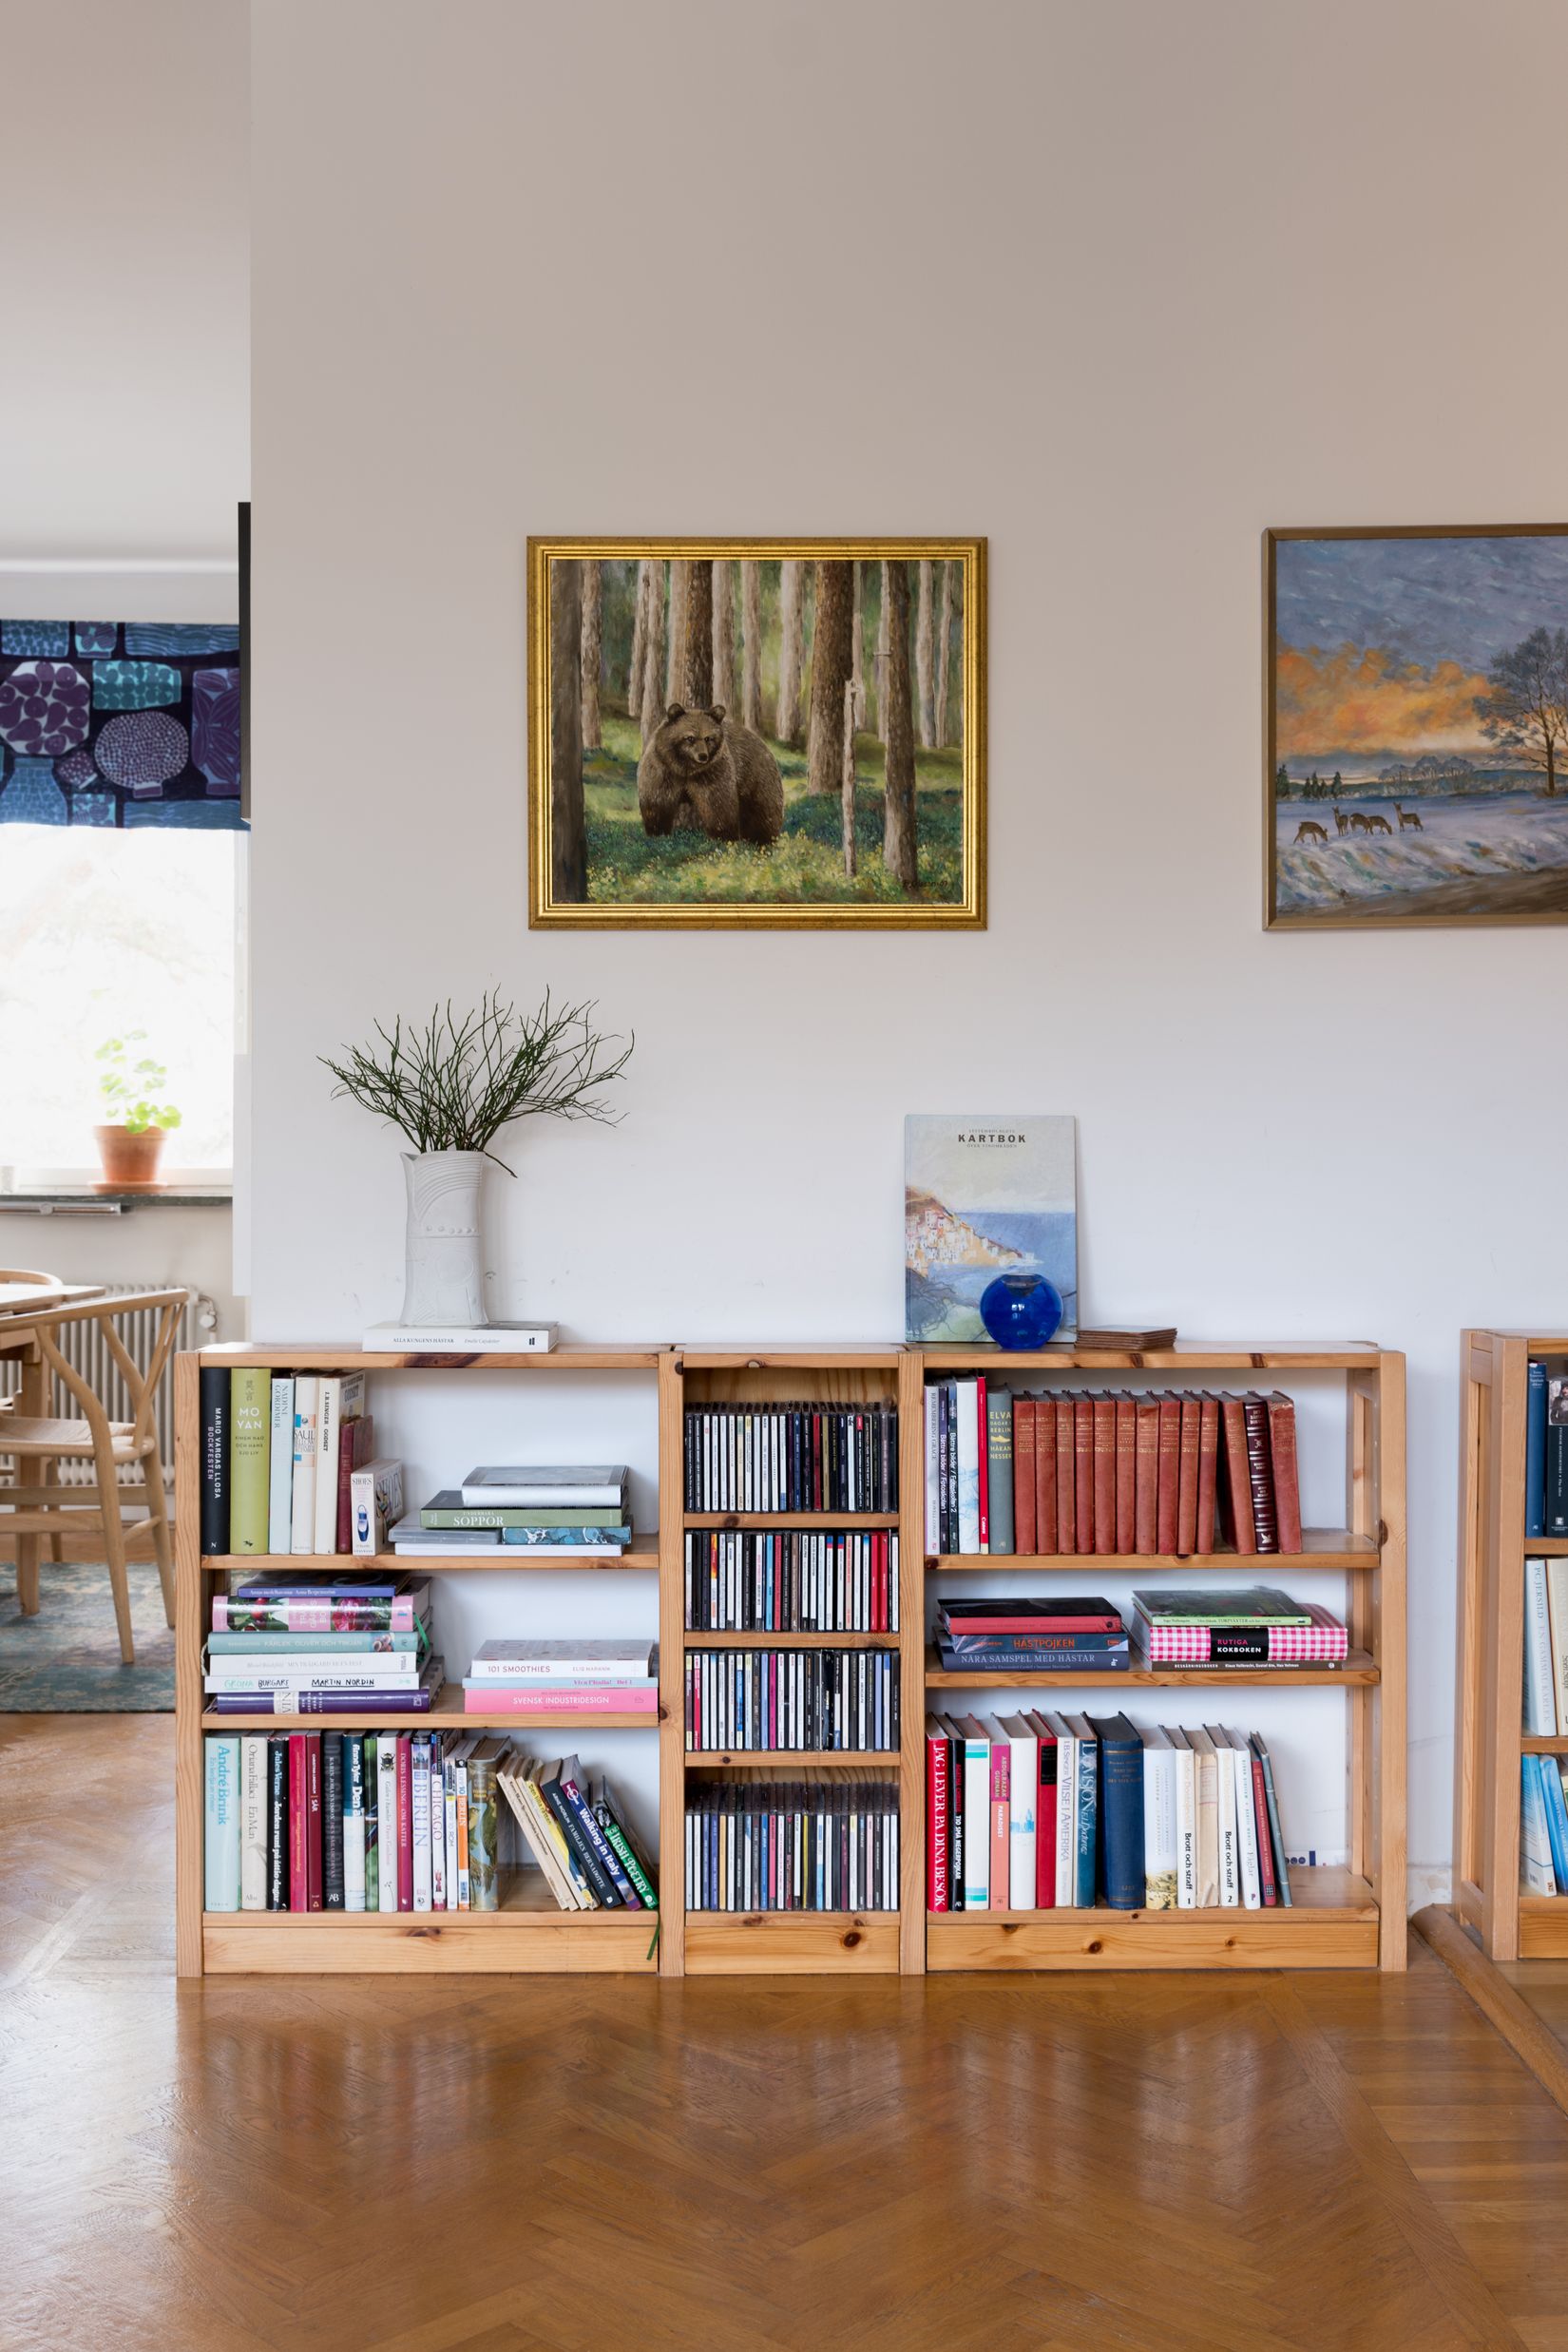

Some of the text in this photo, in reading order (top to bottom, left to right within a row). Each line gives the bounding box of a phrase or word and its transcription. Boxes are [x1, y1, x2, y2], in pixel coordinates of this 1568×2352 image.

[239, 1406, 259, 1417] MO
[990, 1411, 1011, 1420] ELVA
[237, 1420, 262, 1429] YAN
[295, 1429, 316, 1440] SAUL
[454, 1517, 504, 1526] SOPPOR
[1534, 1567, 1541, 1580] PC
[1535, 1581, 1544, 1618] JERSILD
[1013, 1638, 1075, 1650] HÄSTPOJKEN
[282, 1692, 291, 1712] VIN
[219, 1746, 230, 1825] André Brink
[248, 1745, 258, 1840] Oriana Fallaci En Man
[528, 1785, 538, 1796] Den
[1061, 1777, 1072, 1804] VILSE
[352, 1787, 363, 1808] Den
[274, 1801, 282, 1830] Jorden
[401, 1809, 407, 1821] OM
[414, 1785, 428, 1847] BERLIN
[433, 1781, 443, 1841] CHICAGO
[579, 1807, 602, 1845] Walking
[933, 1745, 947, 1906] JAG LEVER DINA BESÖK
[274, 1830, 282, 1849] runt
[551, 1792, 605, 1889] ARNE NORLIN FAMILJEN BERNADOTTE
[1061, 1811, 1071, 1862] AMERIKA
[272, 1849, 282, 1859] på
[599, 1845, 608, 1855] in
[603, 1855, 621, 1876] Italy
[608, 1833, 628, 1860] IRISH
[623, 1858, 650, 1894] POETRY
[272, 1880, 282, 1903] dagar
